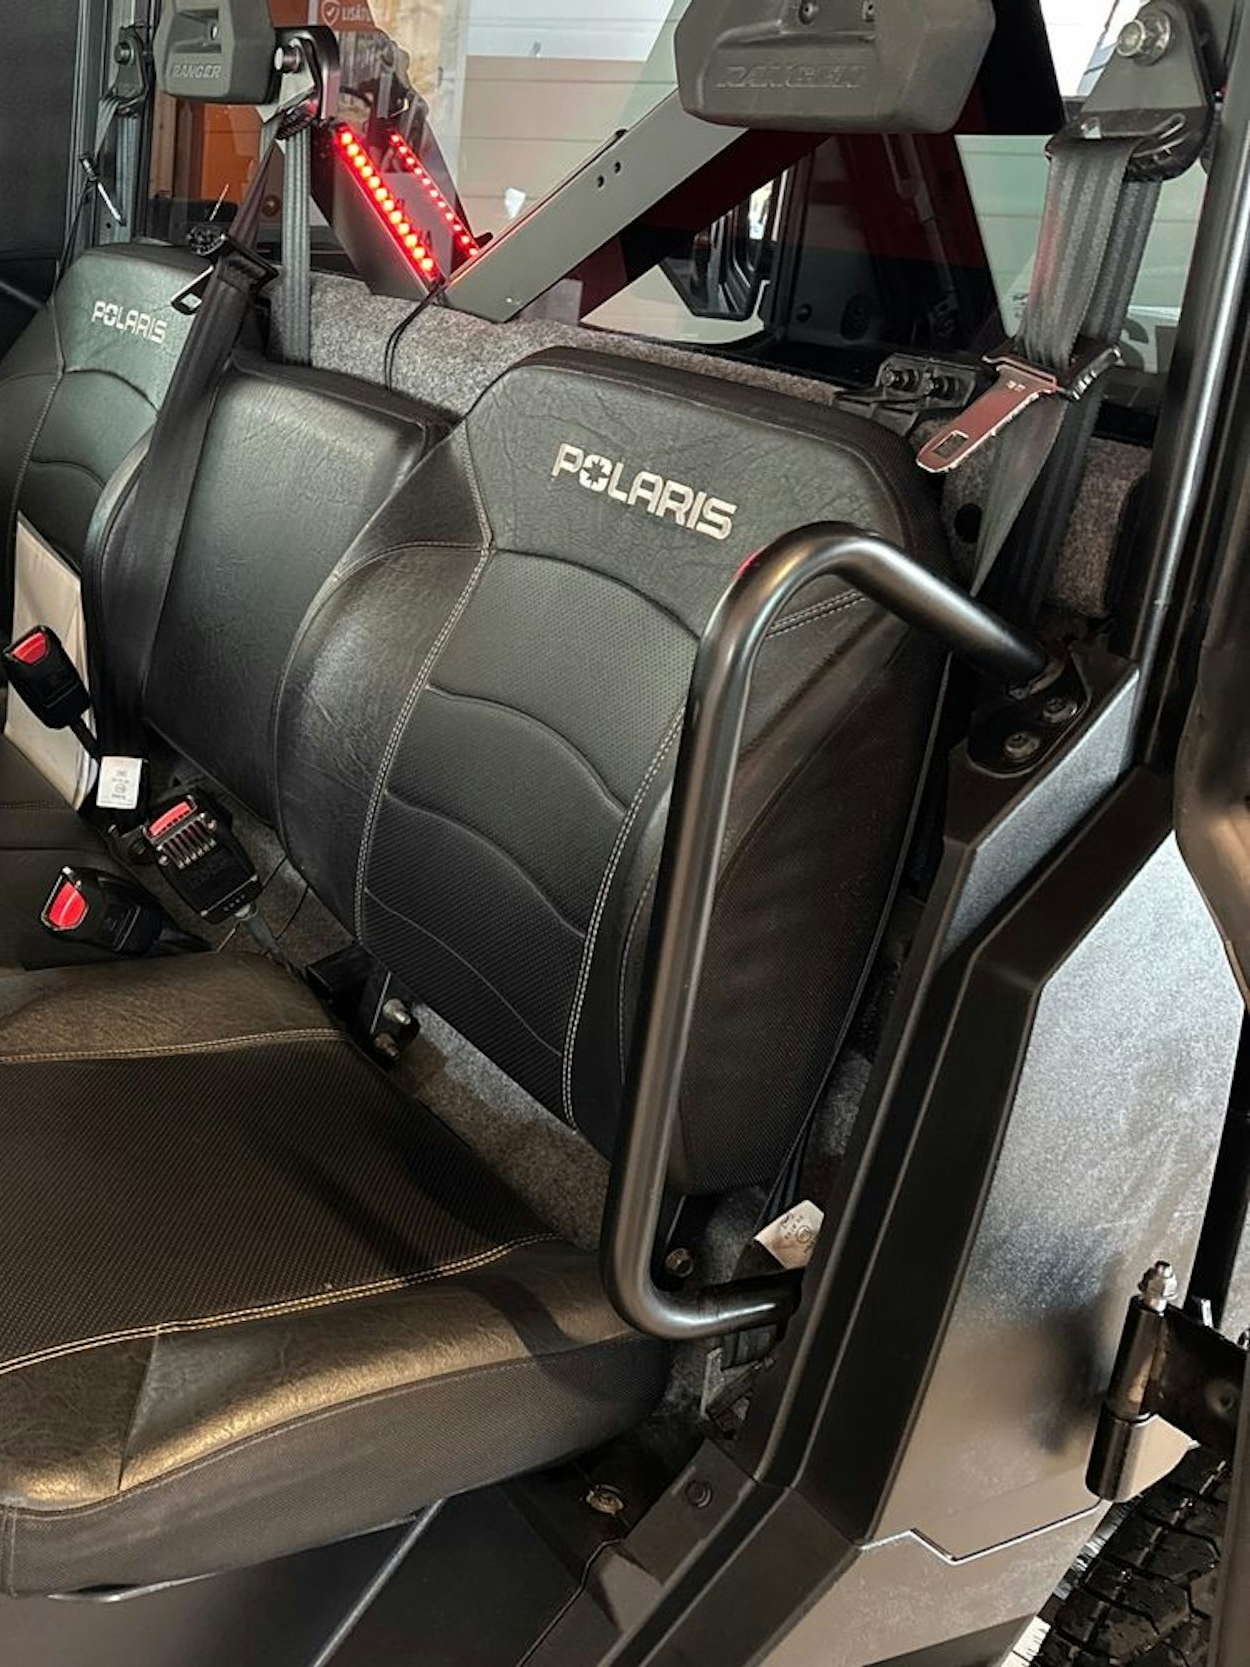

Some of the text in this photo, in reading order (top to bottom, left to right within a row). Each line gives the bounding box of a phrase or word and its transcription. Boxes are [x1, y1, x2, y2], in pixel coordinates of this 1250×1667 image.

[171, 63, 222, 80] RANGER
[91, 300, 168, 344] POLARIS
[551, 443, 737, 540] POLARIS
